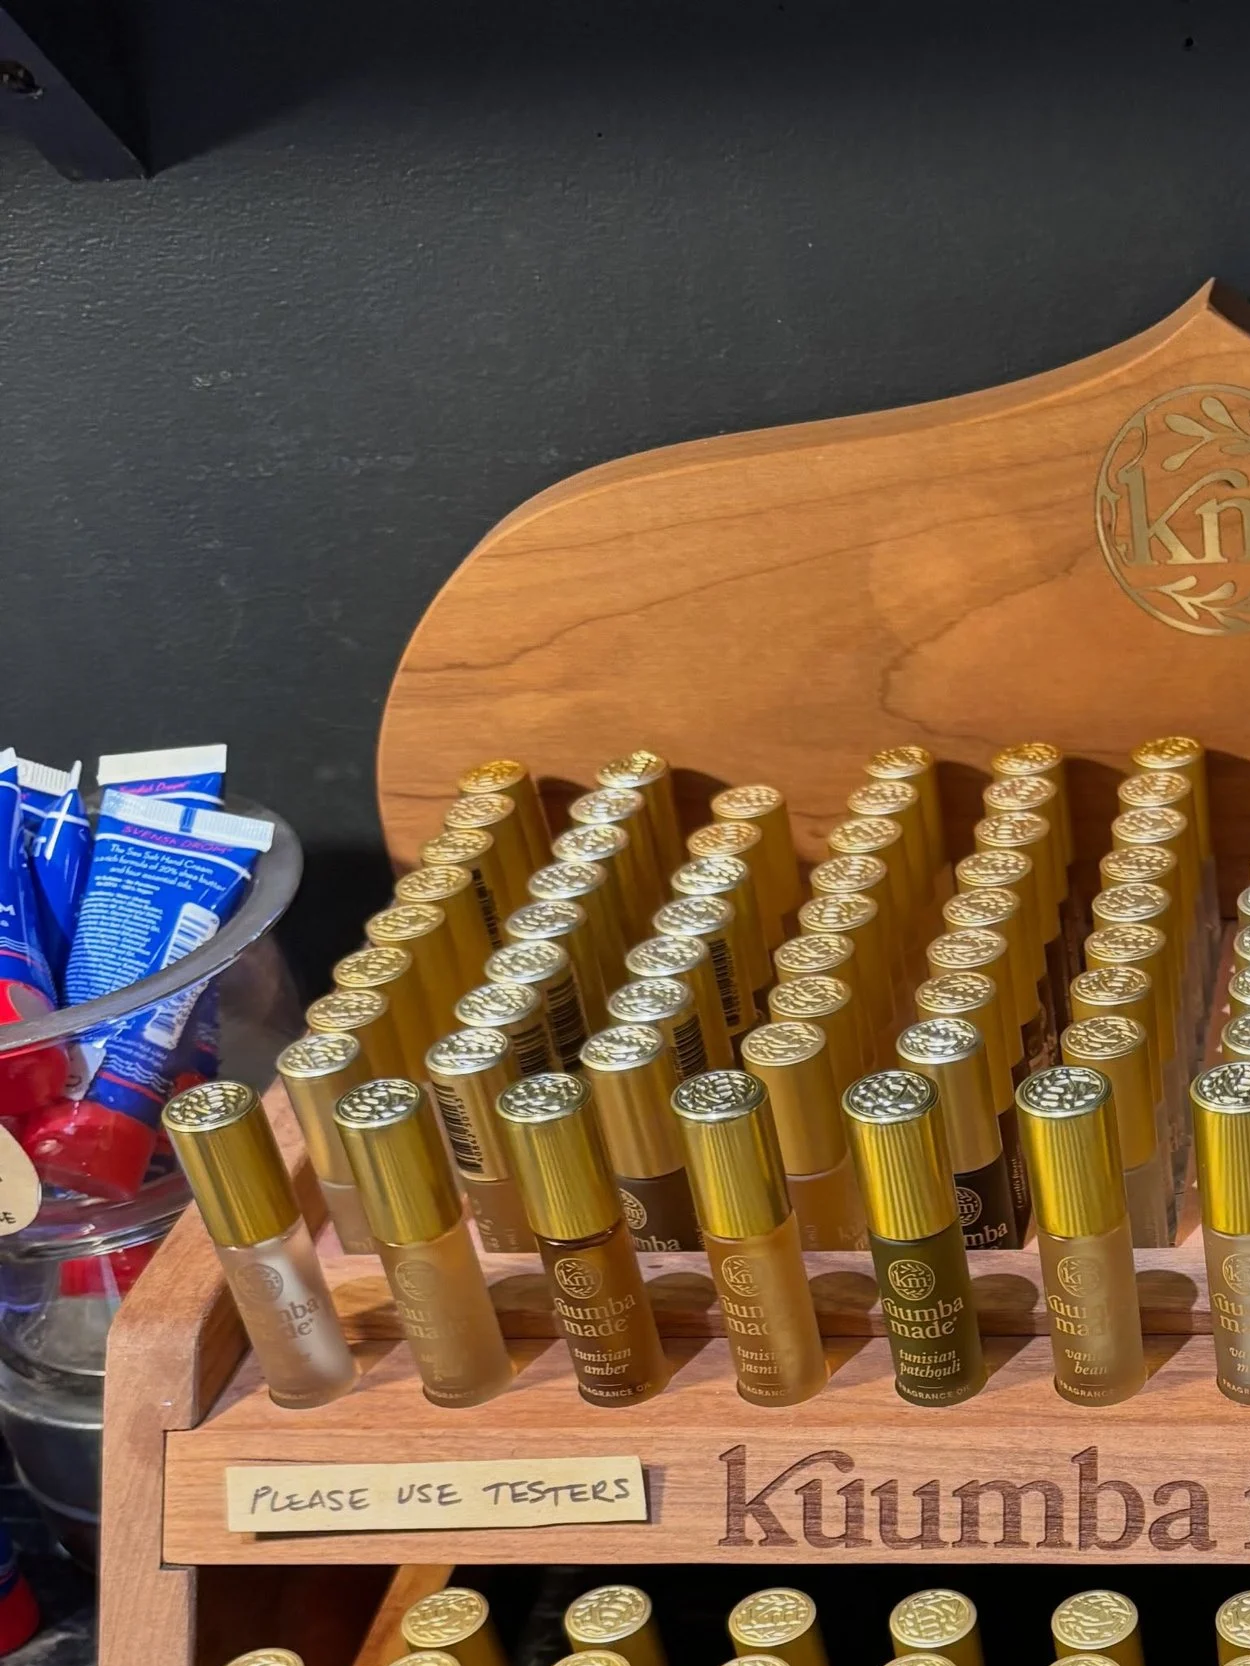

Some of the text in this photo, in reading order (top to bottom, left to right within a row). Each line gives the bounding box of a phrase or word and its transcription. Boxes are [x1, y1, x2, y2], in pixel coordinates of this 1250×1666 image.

[890, 1320, 956, 1340] made
[574, 1348, 632, 1363] tunisian
[899, 1348, 957, 1364] tunisian
[584, 1362, 630, 1376] amber
[900, 1360, 961, 1380] patchouli
[250, 1477, 630, 1515] PLEASE USE TESTERS
[718, 1443, 1218, 1551] kuumba
